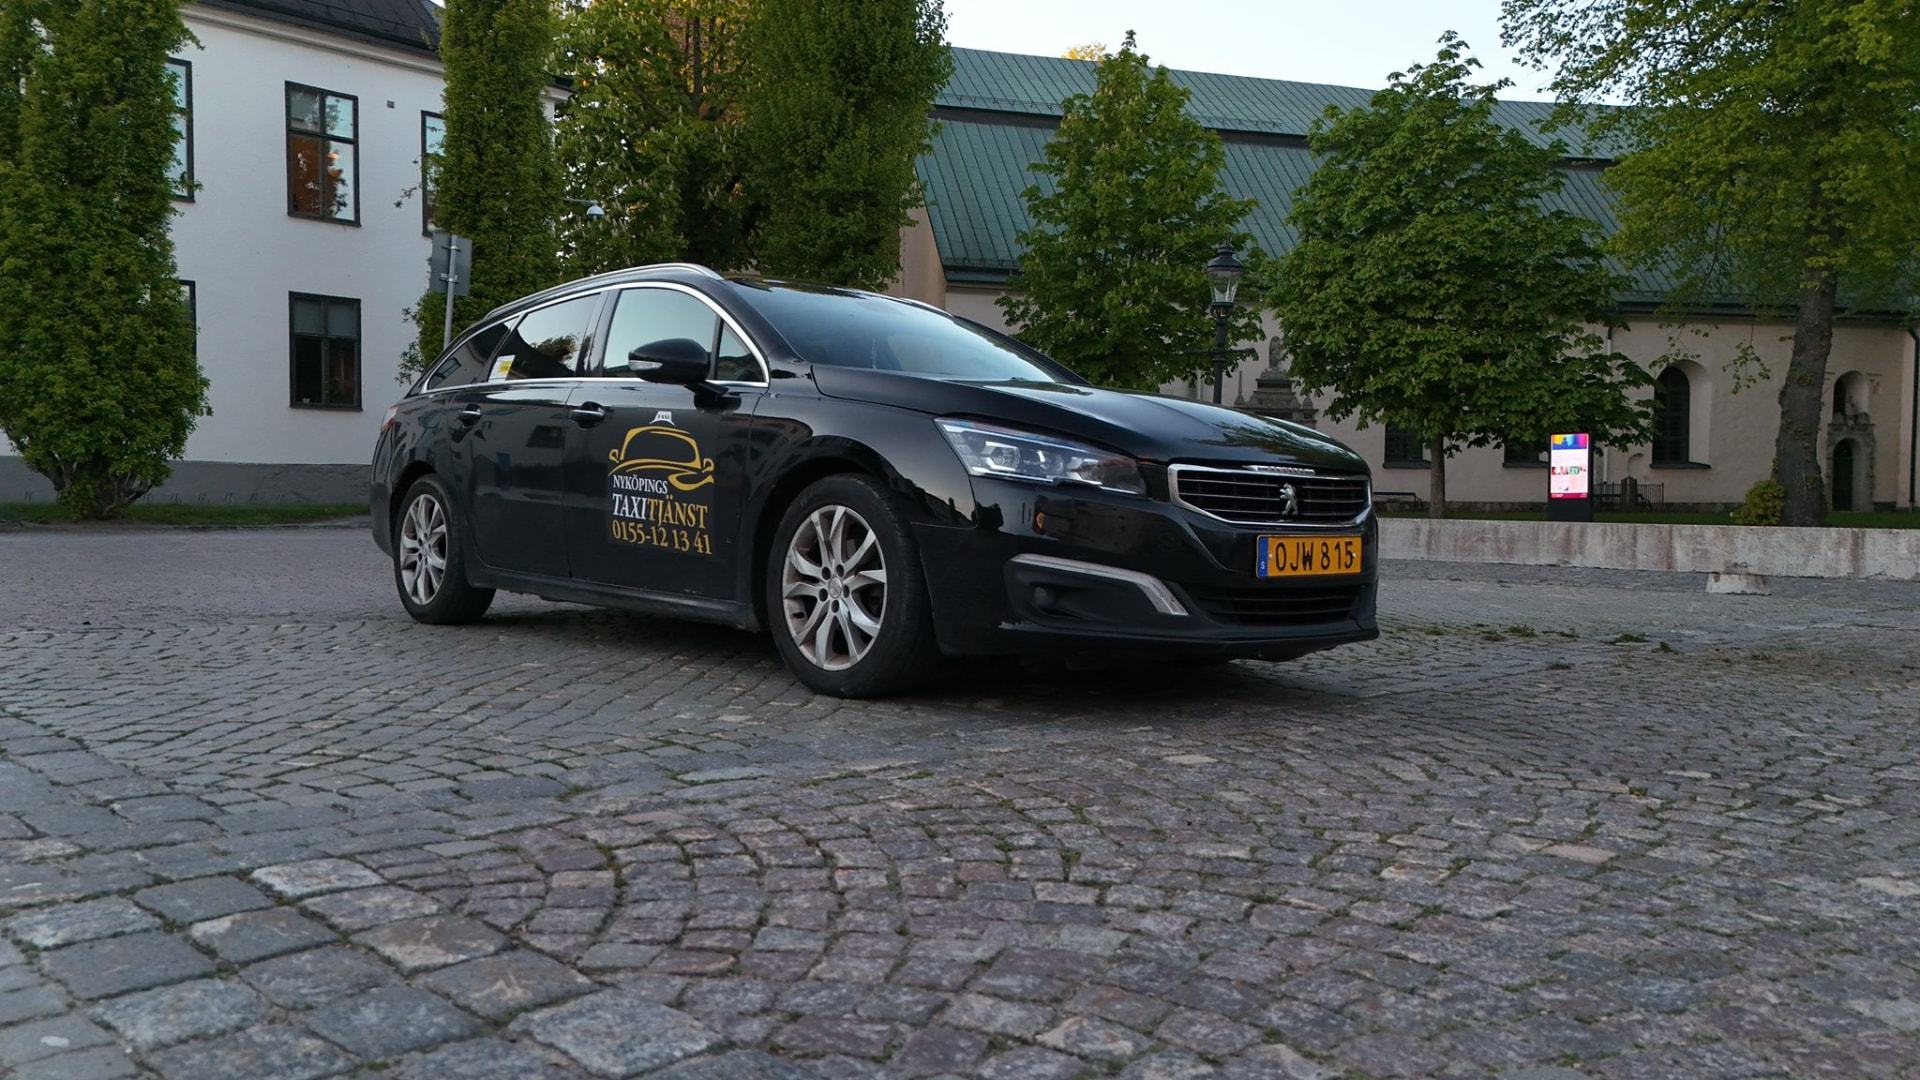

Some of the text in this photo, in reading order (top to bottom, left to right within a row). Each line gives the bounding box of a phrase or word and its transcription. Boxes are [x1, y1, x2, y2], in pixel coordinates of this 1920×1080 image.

[613, 475, 668, 494] NYKÖPINGS
[612, 520, 713, 555] 0155-12 13 41
[1260, 560, 1266, 570] S
[1275, 540, 1354, 571] OJW 815
